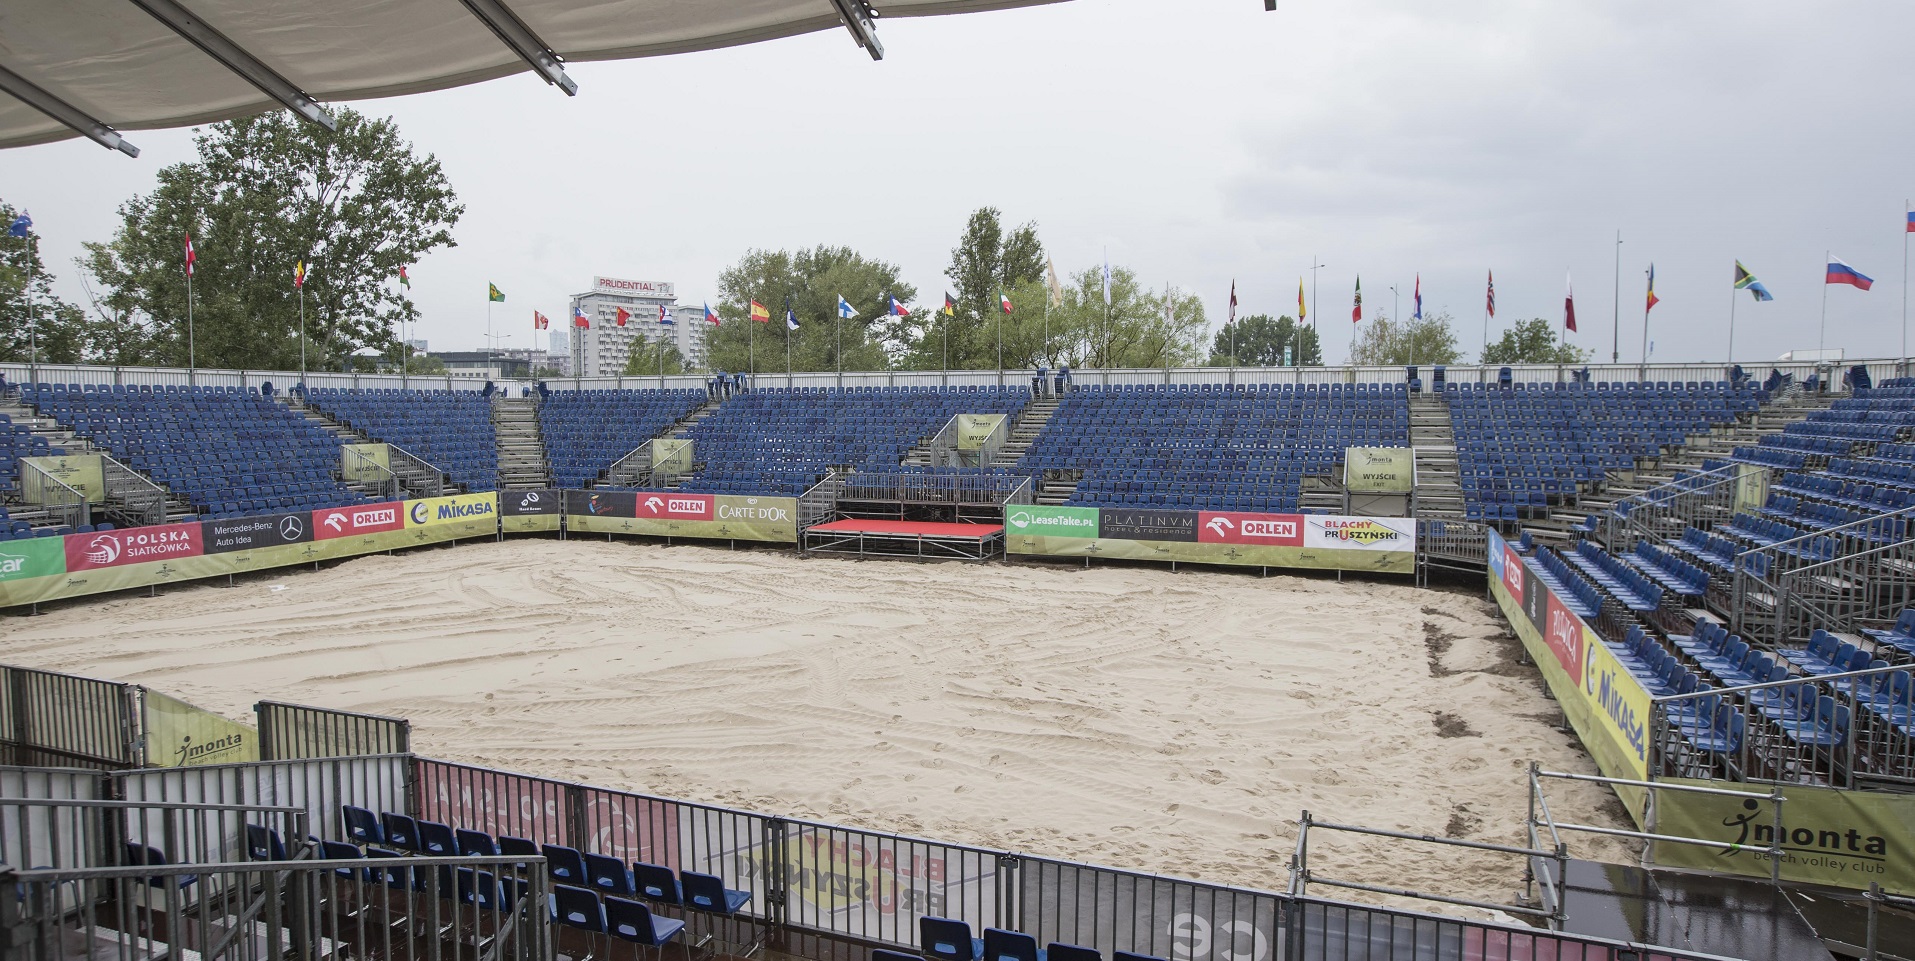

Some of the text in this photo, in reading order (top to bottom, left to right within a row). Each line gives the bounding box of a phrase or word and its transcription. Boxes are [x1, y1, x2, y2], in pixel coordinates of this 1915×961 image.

[599, 278, 655, 291] PRUDENTIAL
[437, 500, 493, 520] MIKASA
[670, 501, 703, 512] ORLEN
[718, 504, 755, 519] CARTE
[355, 511, 393, 525] ORLEN
[1325, 520, 1373, 529] BLACHY
[214, 521, 273, 535] Mercedes-Benz
[1133, 526, 1141, 534] &
[1244, 522, 1293, 535] ORLEN
[1324, 529, 1398, 541] PRUSZYŃSKI
[126, 530, 190, 546] POLSKA
[215, 536, 252, 547] Auto Idea
[127, 542, 191, 557] SIATKÓWKA
[0, 557, 25, 573] ar
[189, 733, 242, 757] monta
[1754, 822, 1886, 856] monta
[1753, 850, 1885, 874] bech volley club
